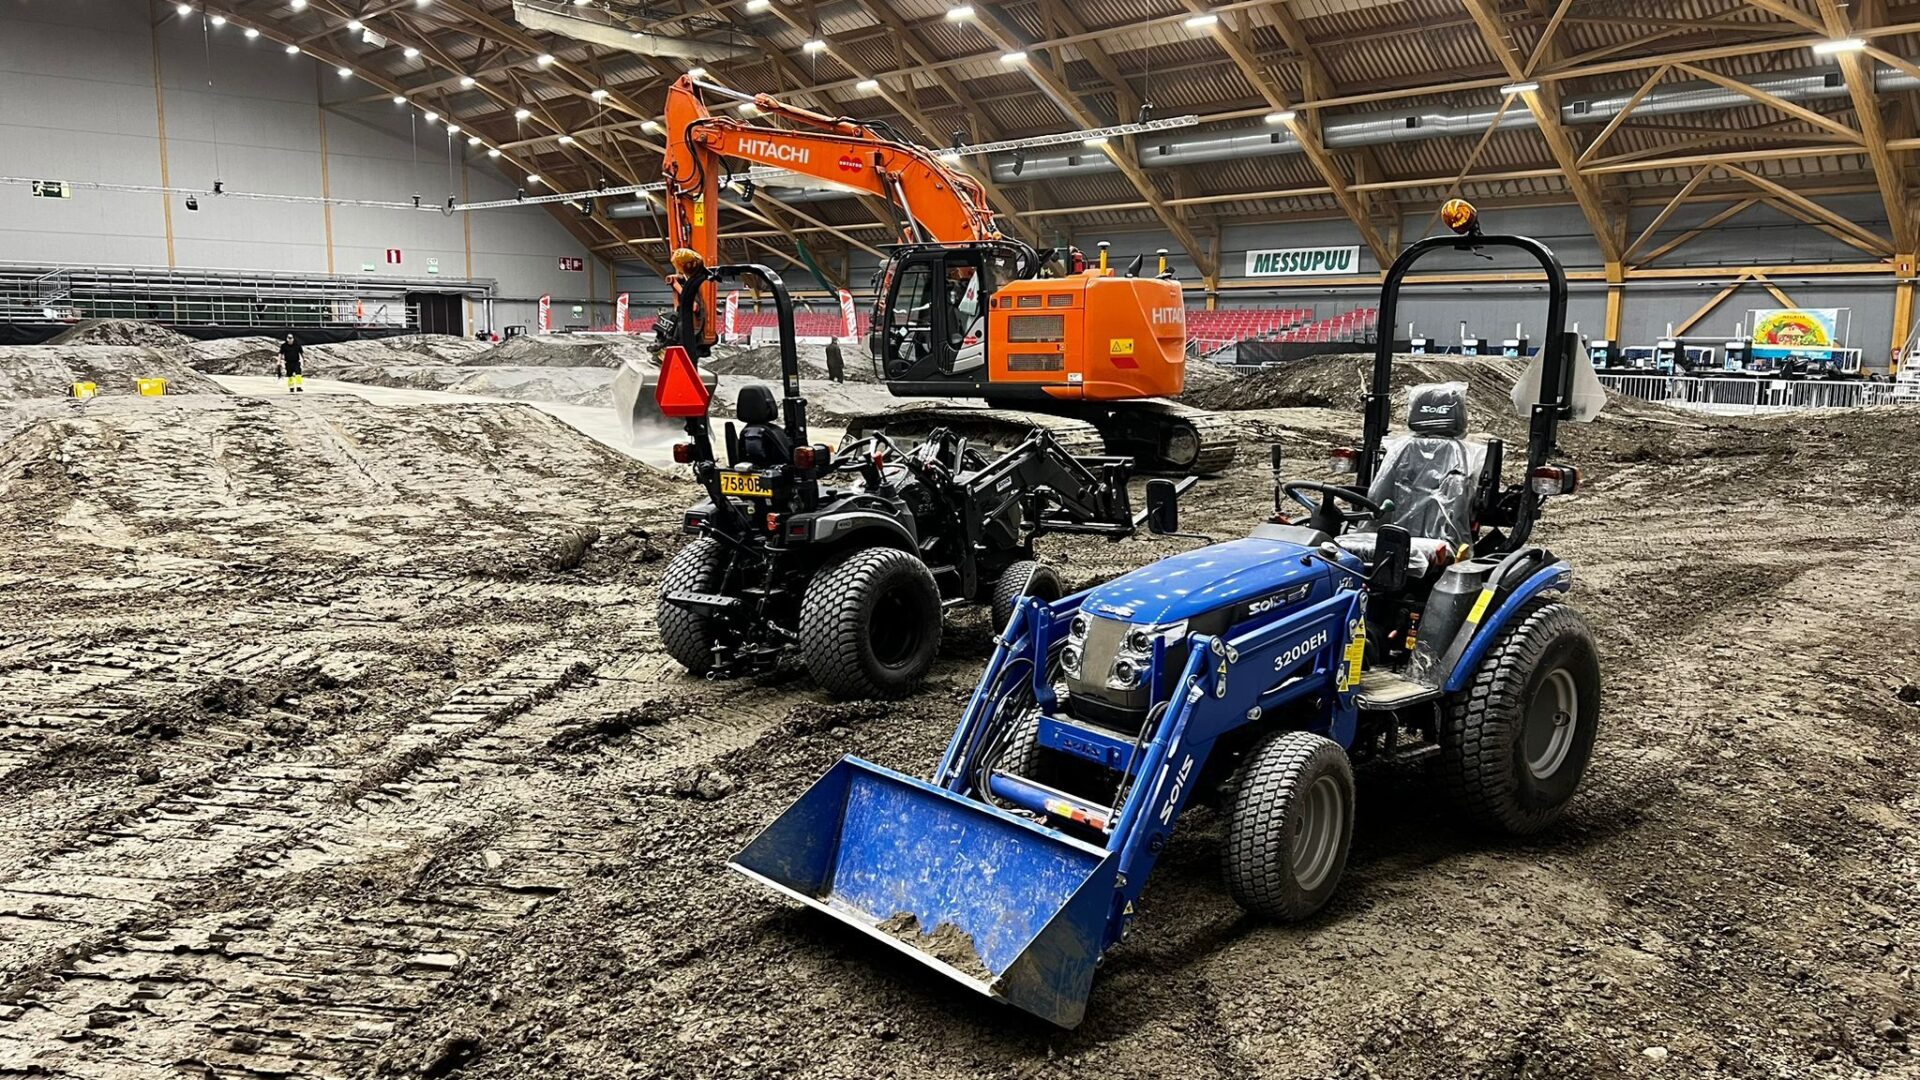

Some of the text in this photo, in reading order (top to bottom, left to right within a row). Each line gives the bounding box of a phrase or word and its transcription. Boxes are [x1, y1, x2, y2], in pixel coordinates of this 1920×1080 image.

[738, 137, 810, 164] HITACHI
[1253, 249, 1352, 273] MESSUPUU
[1273, 629, 1328, 672] 3200EH
